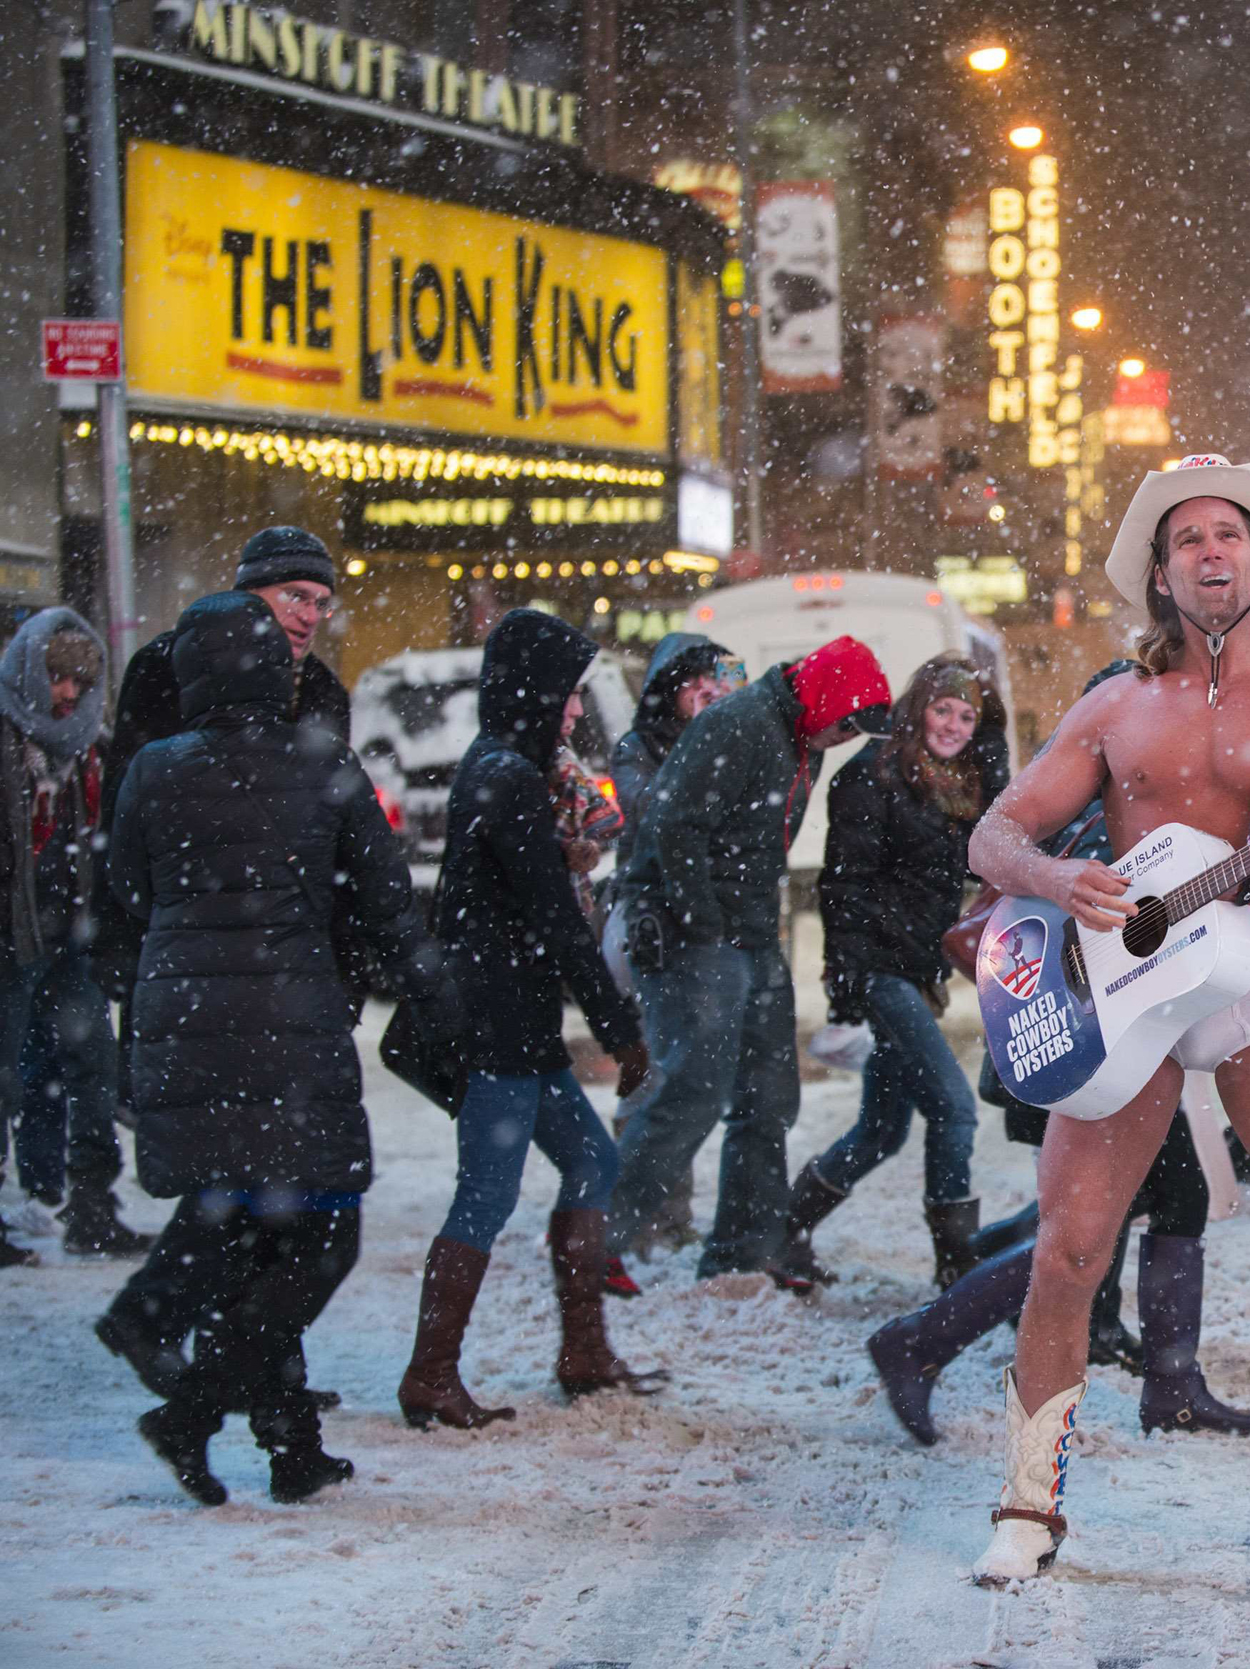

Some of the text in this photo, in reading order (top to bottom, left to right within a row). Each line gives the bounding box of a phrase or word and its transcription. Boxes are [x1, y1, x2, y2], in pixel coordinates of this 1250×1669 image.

[221, 209, 636, 419] THE LION KING
[988, 187, 1026, 423] BOOTH
[1119, 836, 1173, 876] UE ISLAND
[1136, 849, 1175, 877] Company
[1105, 925, 1208, 997] NAKEDCOWBOYOYSTERS.COM
[1006, 1006, 1068, 1062] COWBOY
[1008, 991, 1056, 1038] NAKED
[1013, 1029, 1074, 1082] OYSTERS
